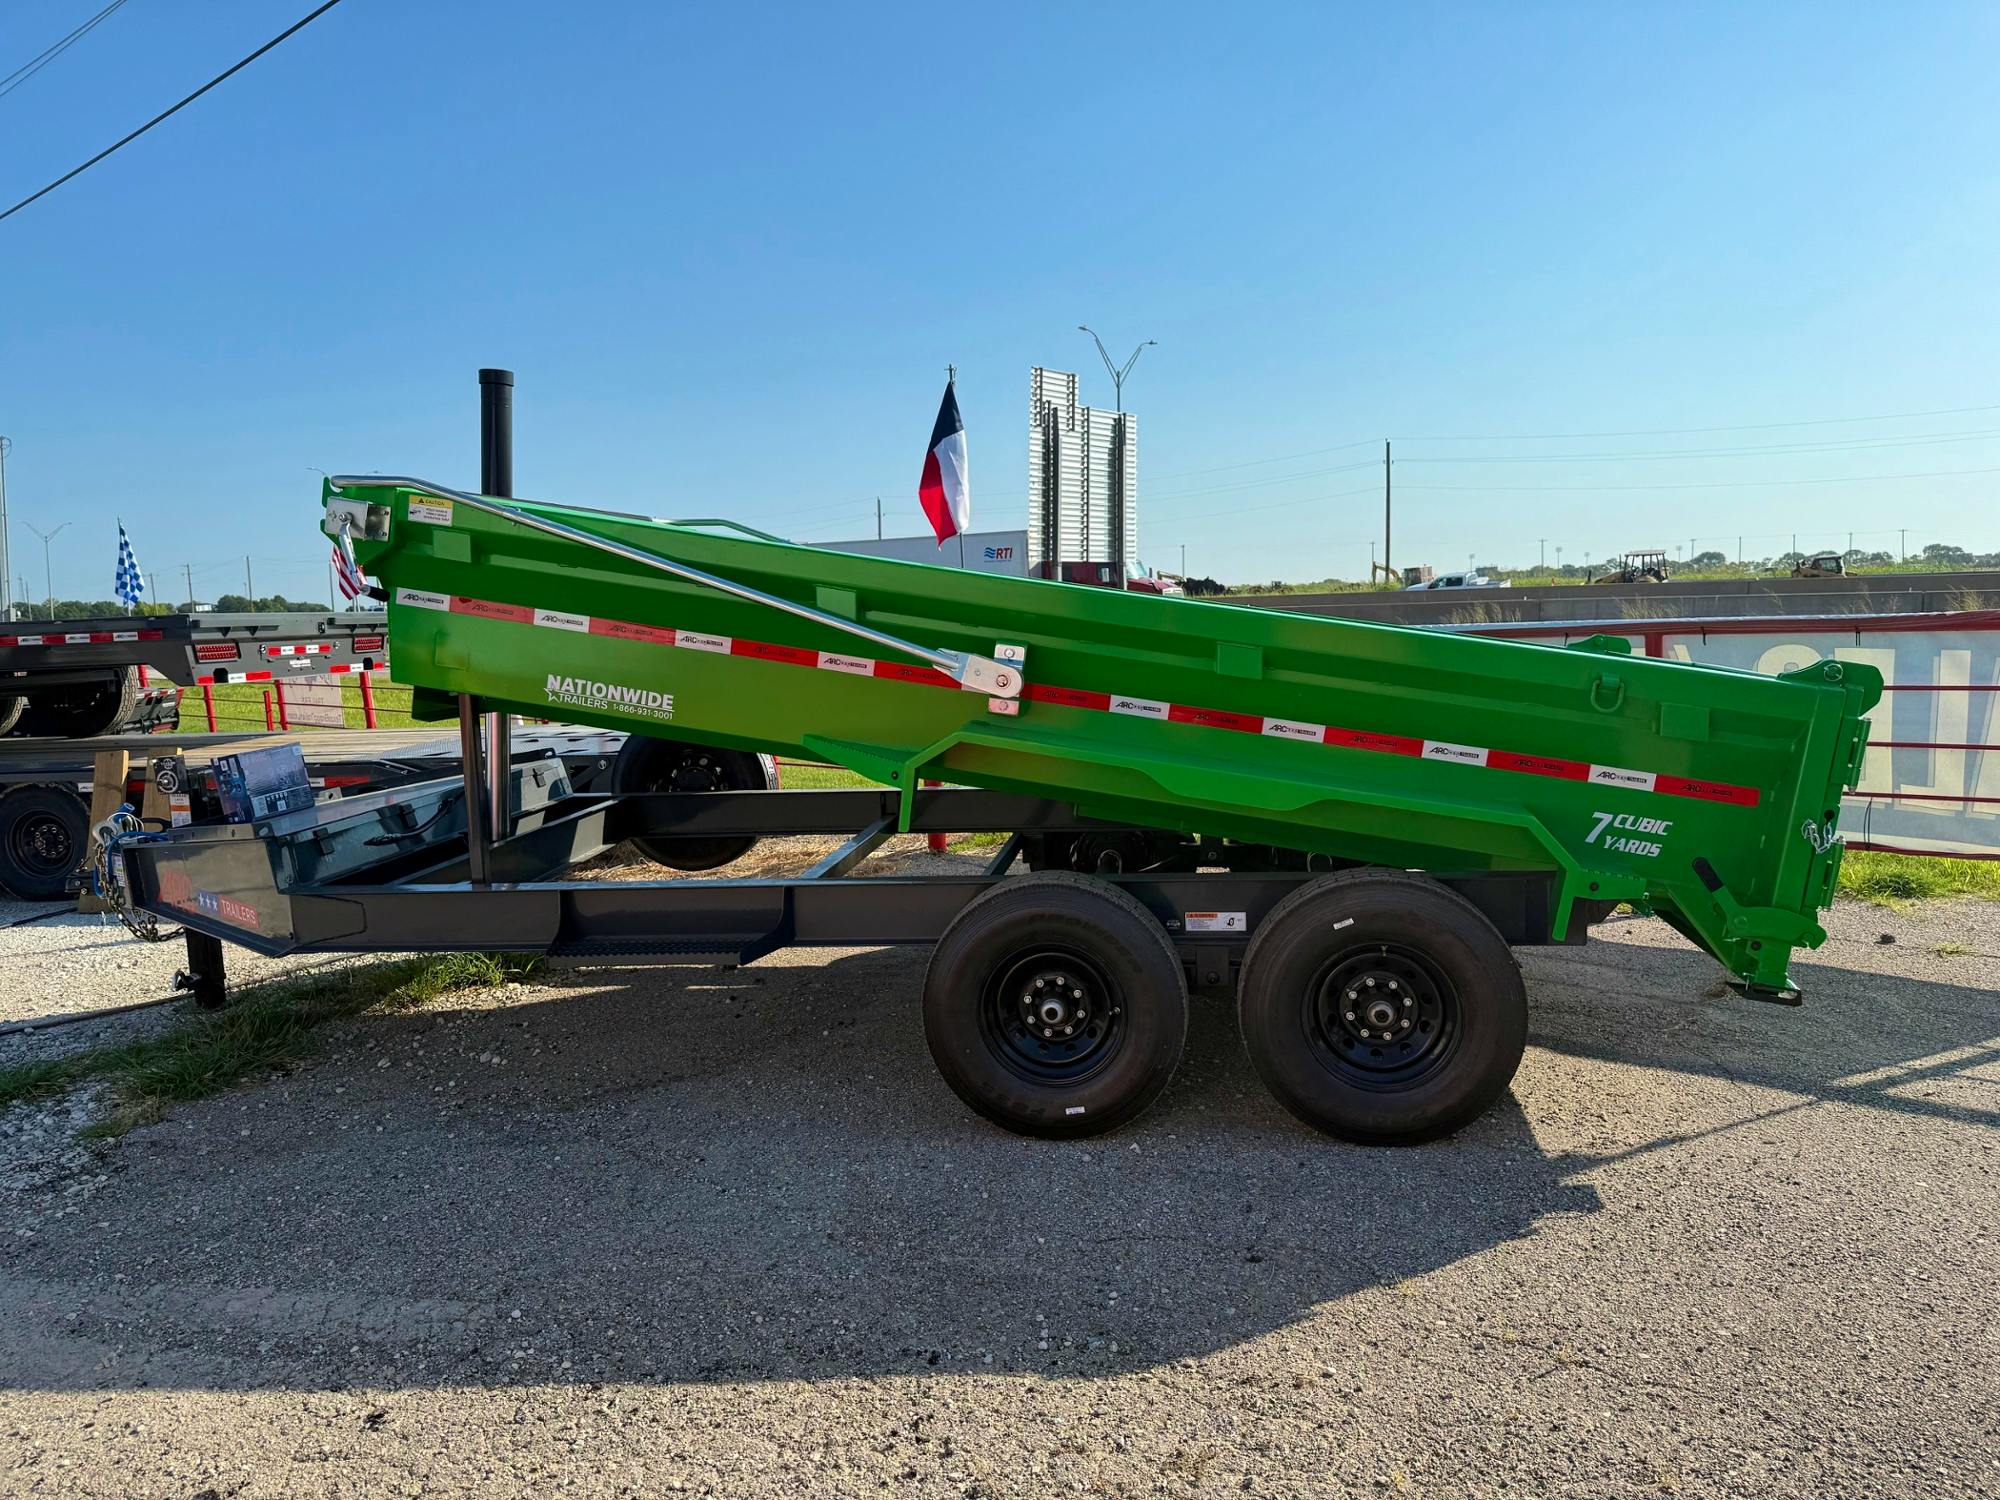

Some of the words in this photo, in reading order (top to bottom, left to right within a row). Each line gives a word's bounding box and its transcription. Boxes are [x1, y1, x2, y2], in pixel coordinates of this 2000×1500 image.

[425, 498, 445, 506] CAUTION
[996, 547, 1013, 560] RTI
[541, 614, 558, 623] ARC
[680, 635, 697, 644] ARC
[824, 657, 841, 666] ARC
[546, 674, 675, 710] NATIONWIDE
[558, 693, 608, 710] TRAILERS
[613, 703, 673, 720] 1-866-931-3001
[1115, 701, 1133, 710] ARC
[1268, 724, 1287, 733] ARC
[1429, 746, 1449, 755] ARC
[1596, 770, 1616, 780] ARC
[1585, 811, 1613, 844] 7
[1613, 813, 1673, 836] CUBIC
[1602, 835, 1663, 858] YARDS
[221, 899, 257, 925] TRAILERS
